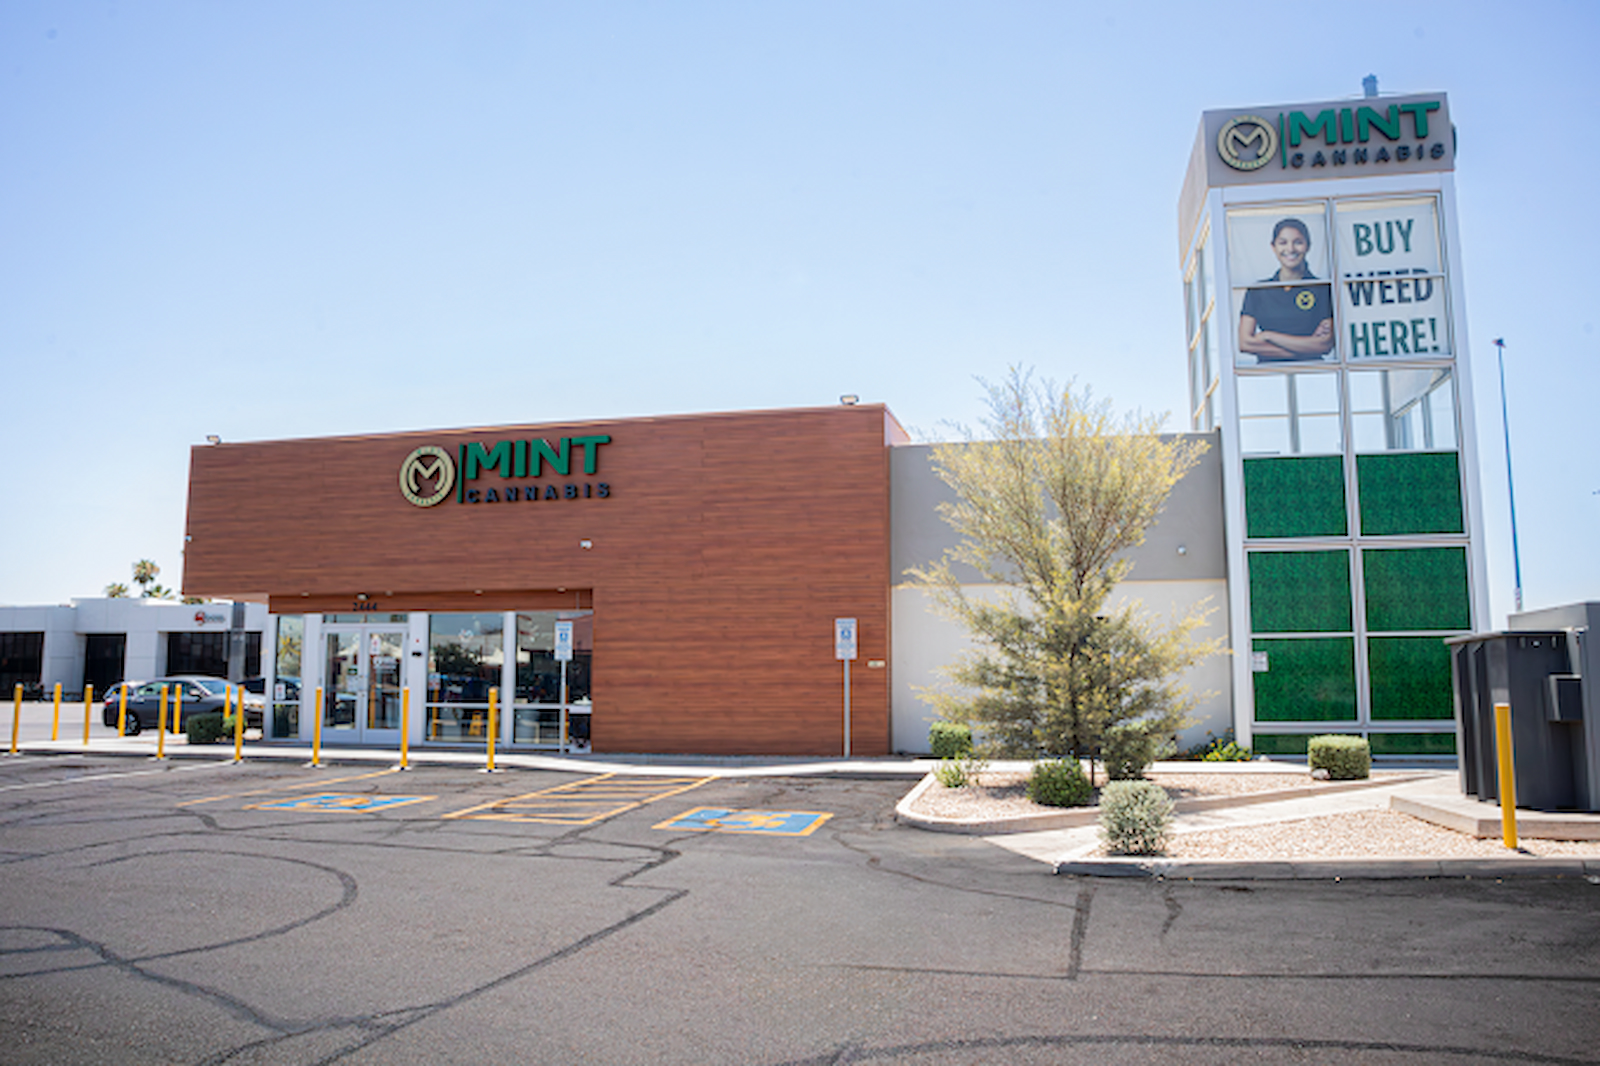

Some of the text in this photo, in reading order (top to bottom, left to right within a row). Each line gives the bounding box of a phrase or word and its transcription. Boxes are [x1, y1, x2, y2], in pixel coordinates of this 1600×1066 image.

[1288, 101, 1441, 147] MINT
[1290, 142, 1445, 169] CANNABIS
[1353, 218, 1414, 257] BUY
[1344, 268, 1434, 307] WEED
[1349, 317, 1440, 358] HERE!
[465, 435, 612, 480] MINT
[465, 482, 611, 504] CANNABIS
